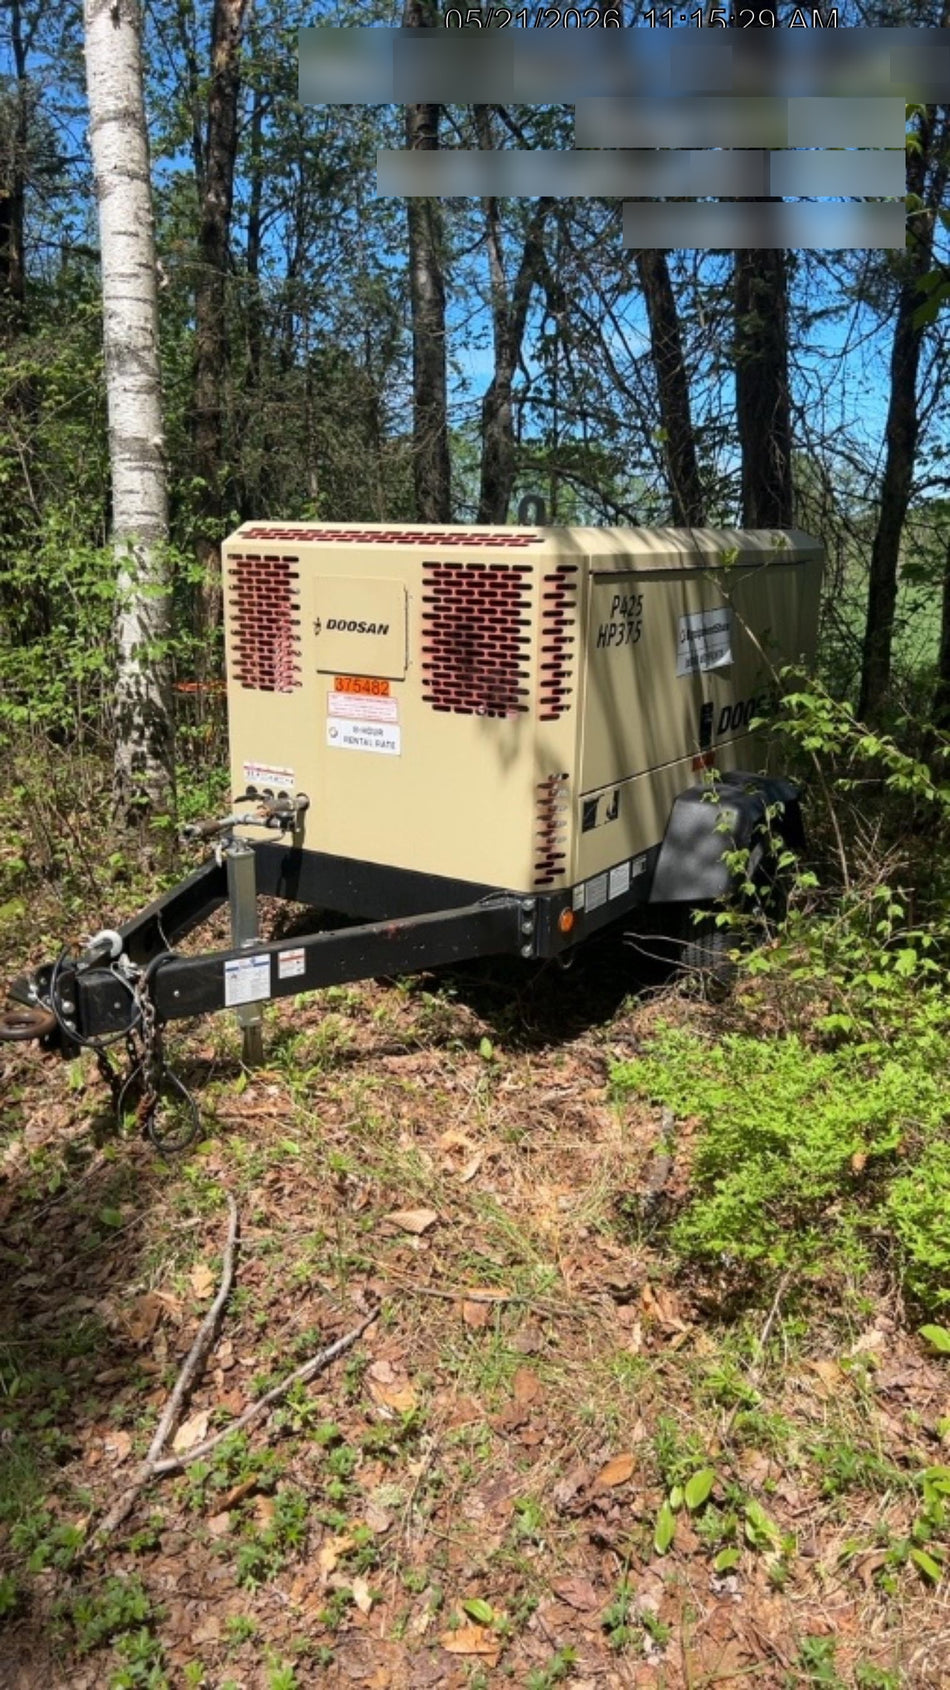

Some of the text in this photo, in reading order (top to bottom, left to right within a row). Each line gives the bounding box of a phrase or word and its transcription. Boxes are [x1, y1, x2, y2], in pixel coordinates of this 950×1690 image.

[610, 595, 644, 618] P425
[326, 618, 389, 635] DOOSAN
[597, 620, 643, 648] HP375
[335, 677, 390, 696] 375482
[343, 735, 396, 750] RENTAL RATE
